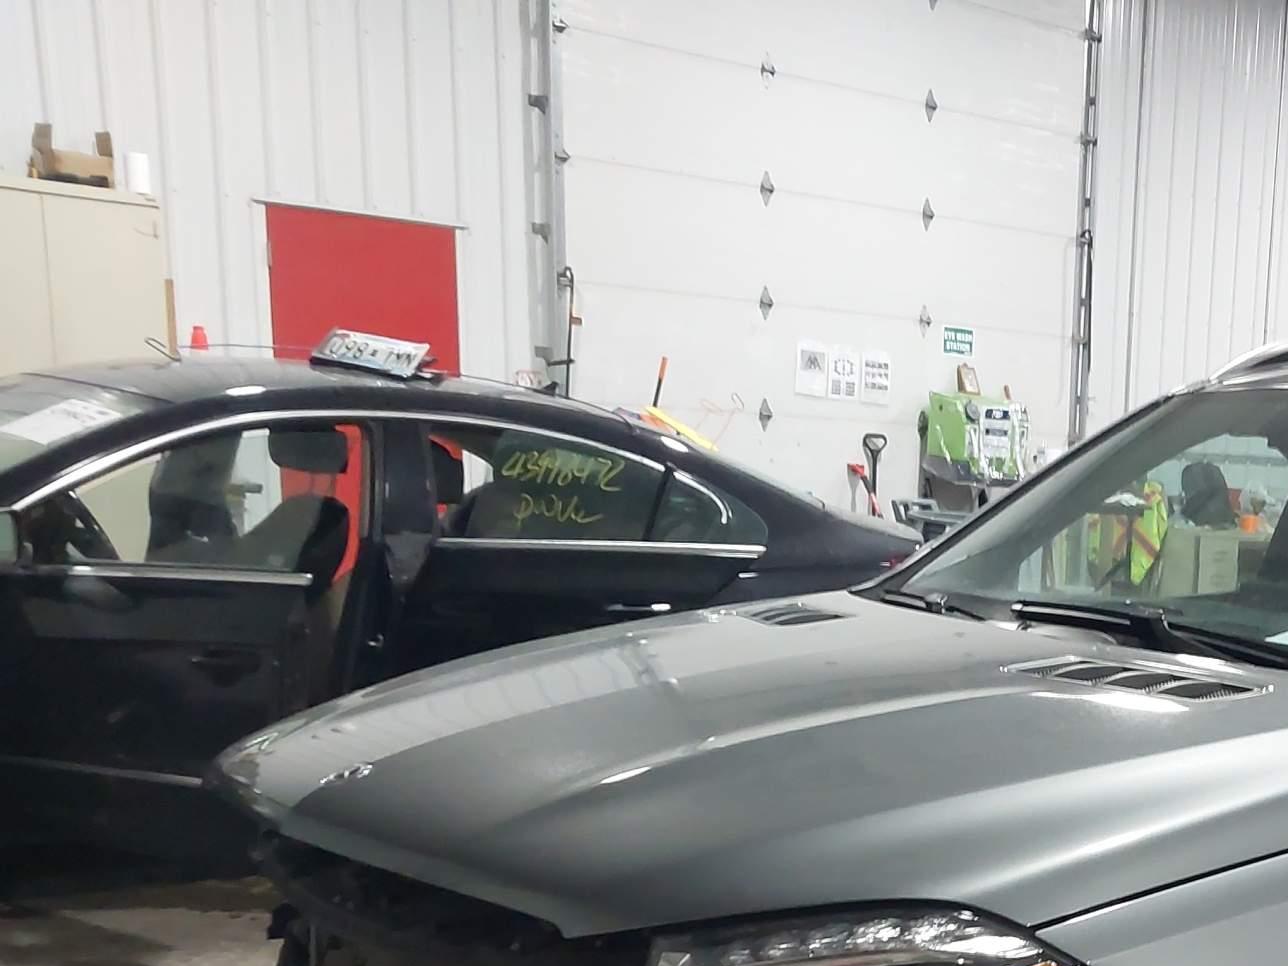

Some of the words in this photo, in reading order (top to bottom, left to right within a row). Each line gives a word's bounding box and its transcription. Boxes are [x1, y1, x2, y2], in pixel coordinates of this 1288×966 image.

[944, 331, 956, 341] EYE
[956, 332, 973, 343] WASH
[946, 340, 970, 352] STATION
